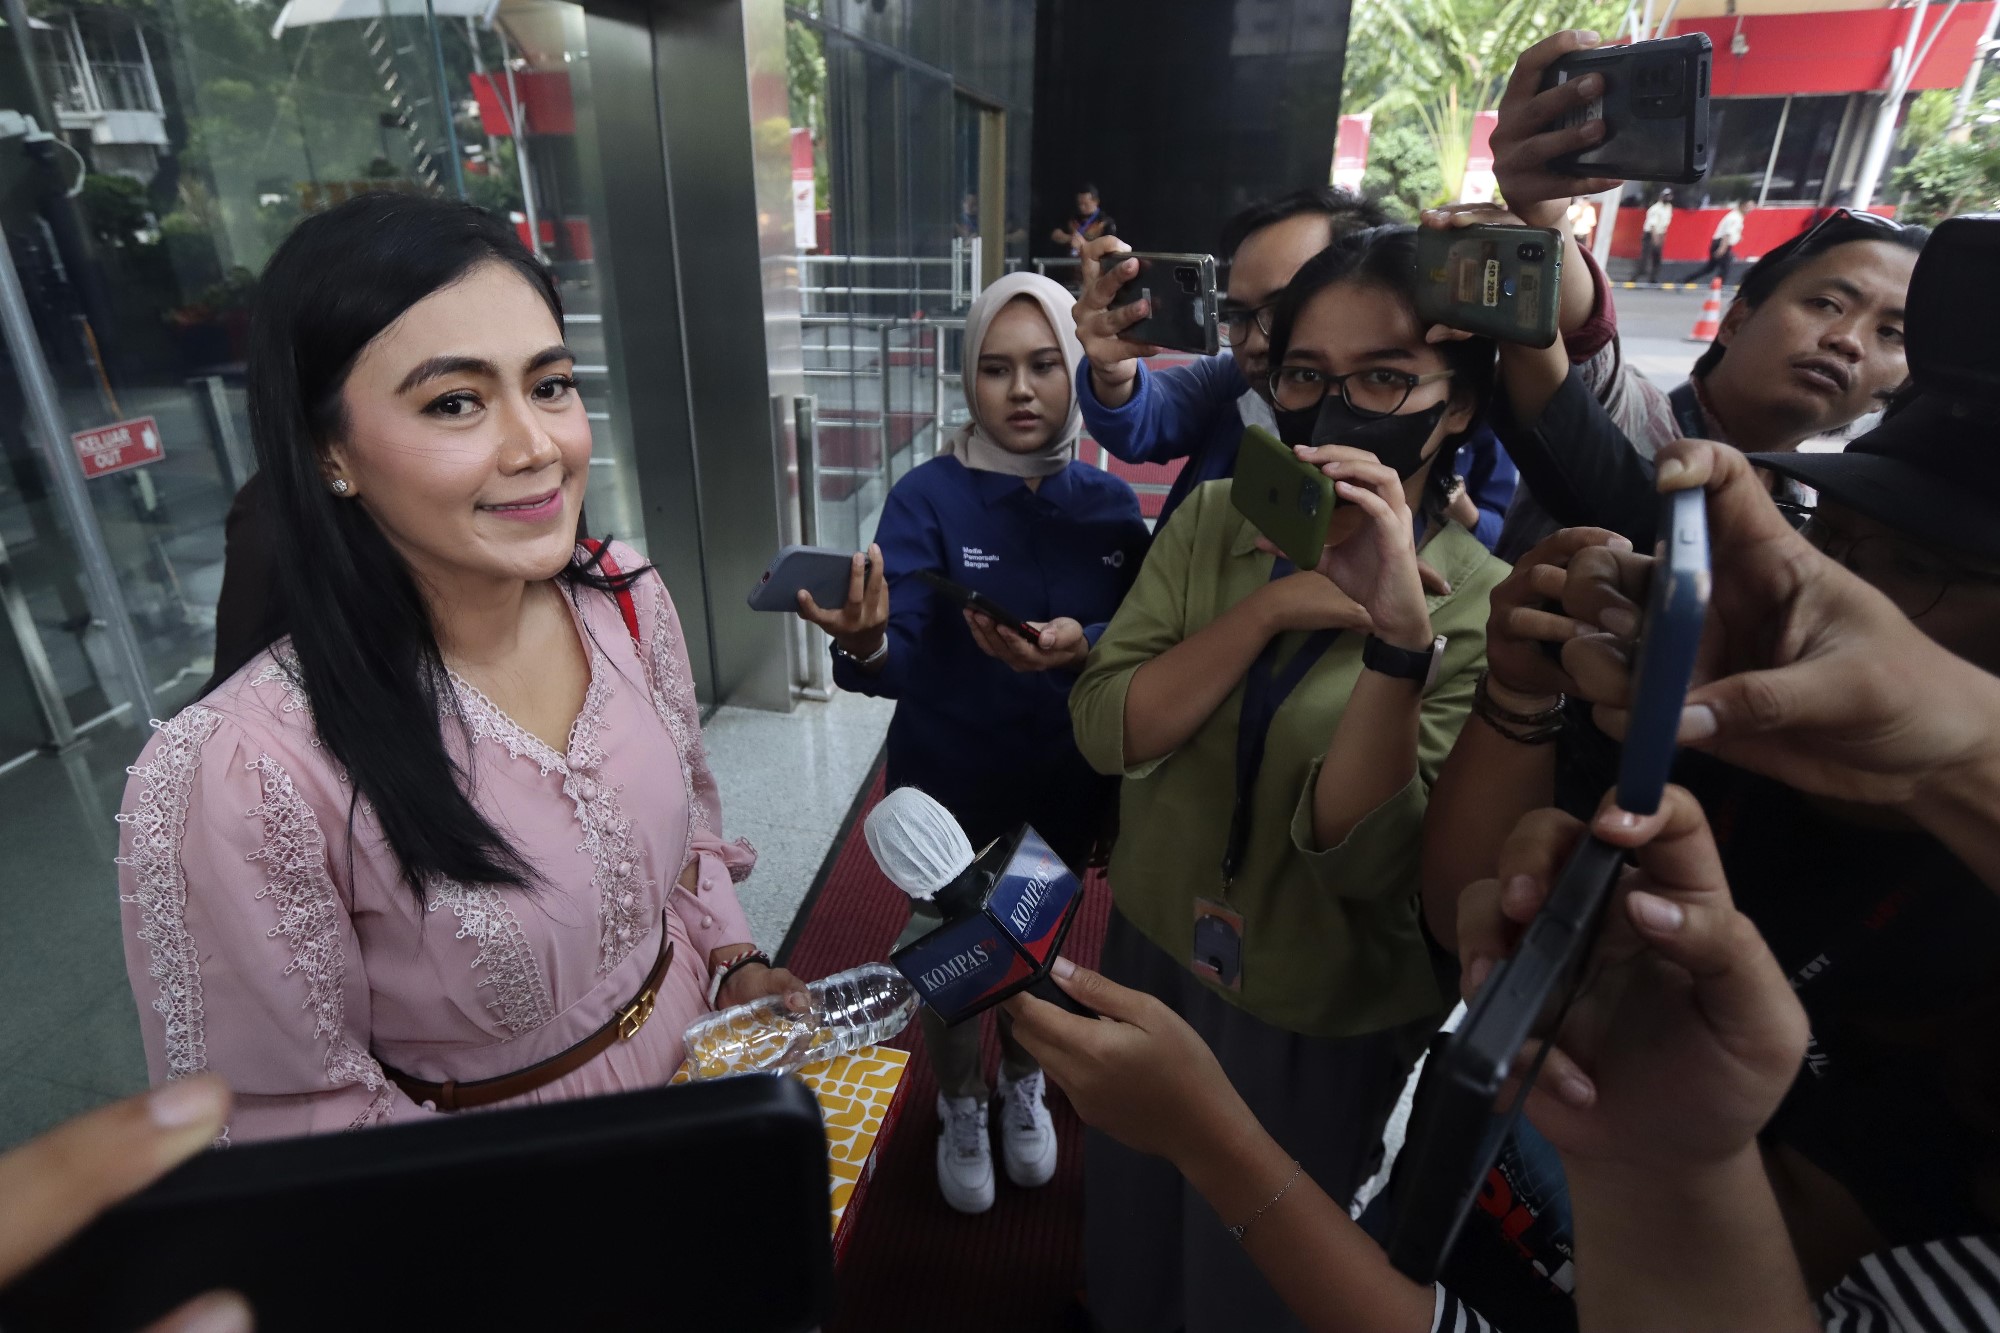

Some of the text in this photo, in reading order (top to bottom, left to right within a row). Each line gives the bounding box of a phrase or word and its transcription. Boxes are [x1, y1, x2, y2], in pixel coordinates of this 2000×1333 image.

[79, 427, 132, 454] KELUAR
[94, 449, 122, 468] OUT
[964, 560, 990, 570] Bangsa
[1010, 865, 1050, 934] KOMPAS
[920, 944, 989, 992] KOMPAS
